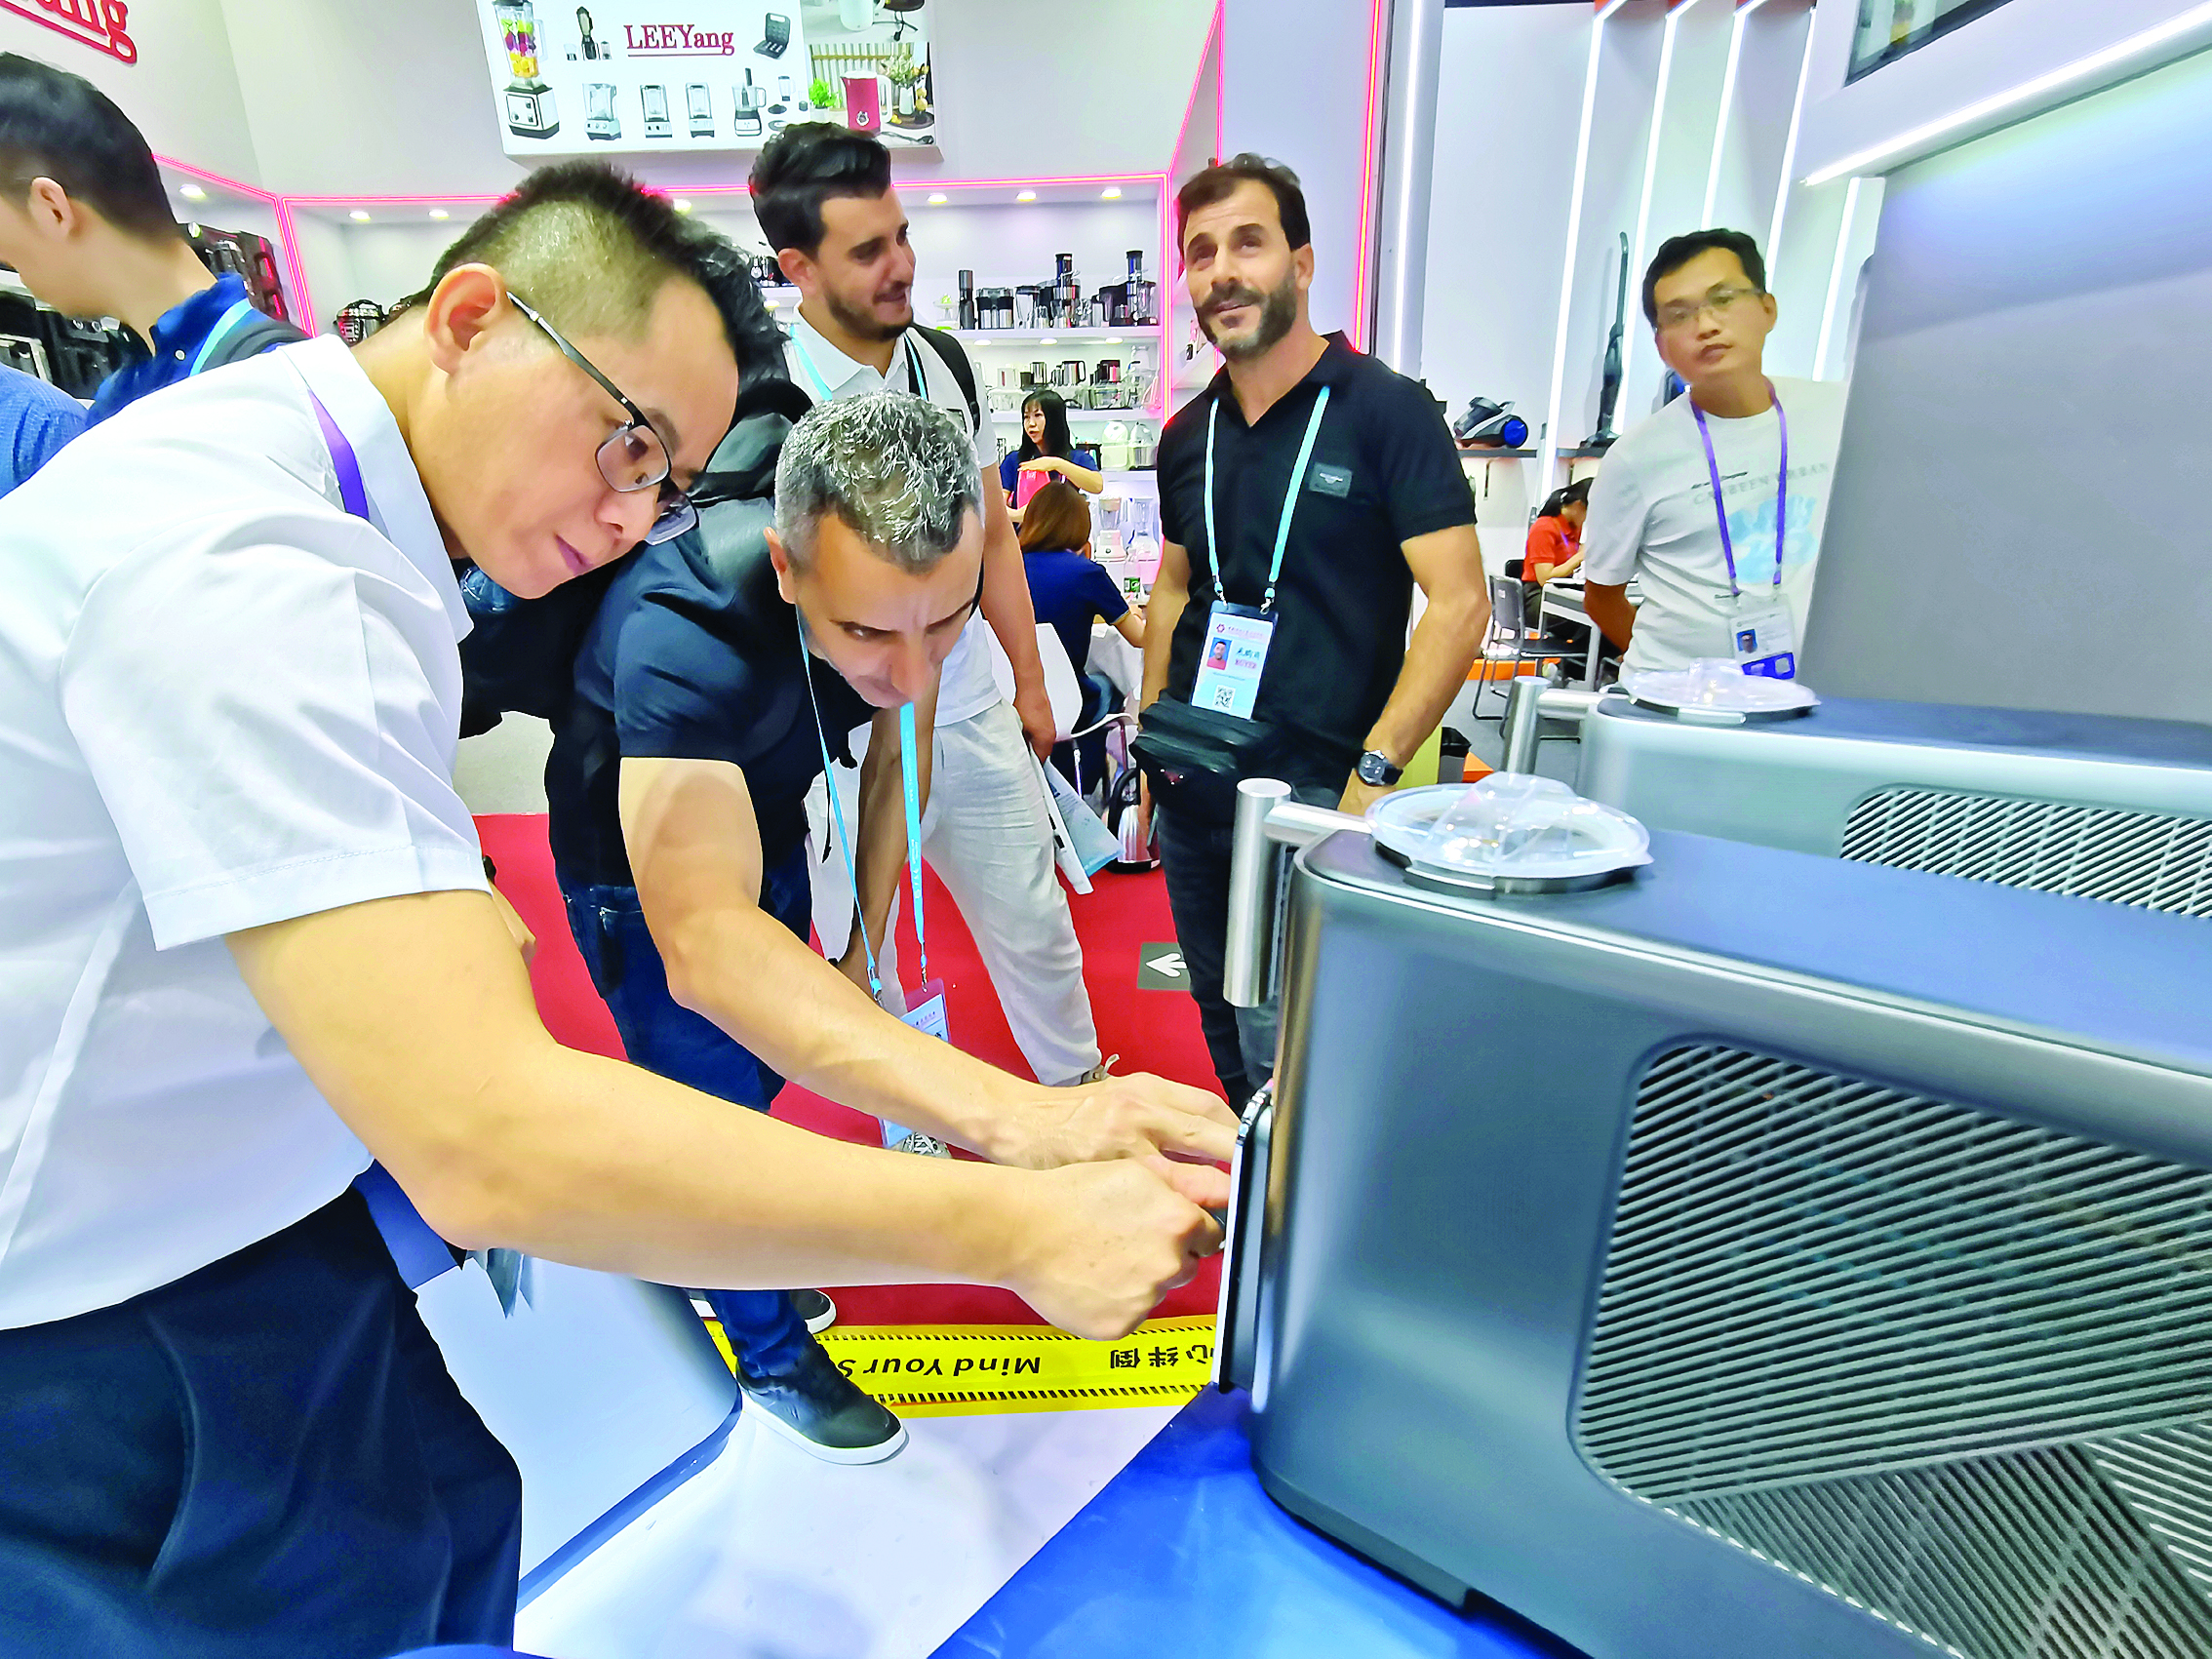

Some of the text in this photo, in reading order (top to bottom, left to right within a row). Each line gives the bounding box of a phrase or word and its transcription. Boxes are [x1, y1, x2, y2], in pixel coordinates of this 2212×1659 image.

[623, 24, 735, 57] LEEYang
[837, 1357, 1041, 1378] Mind Your S
[1110, 1344, 1214, 1369] 心绊倒
